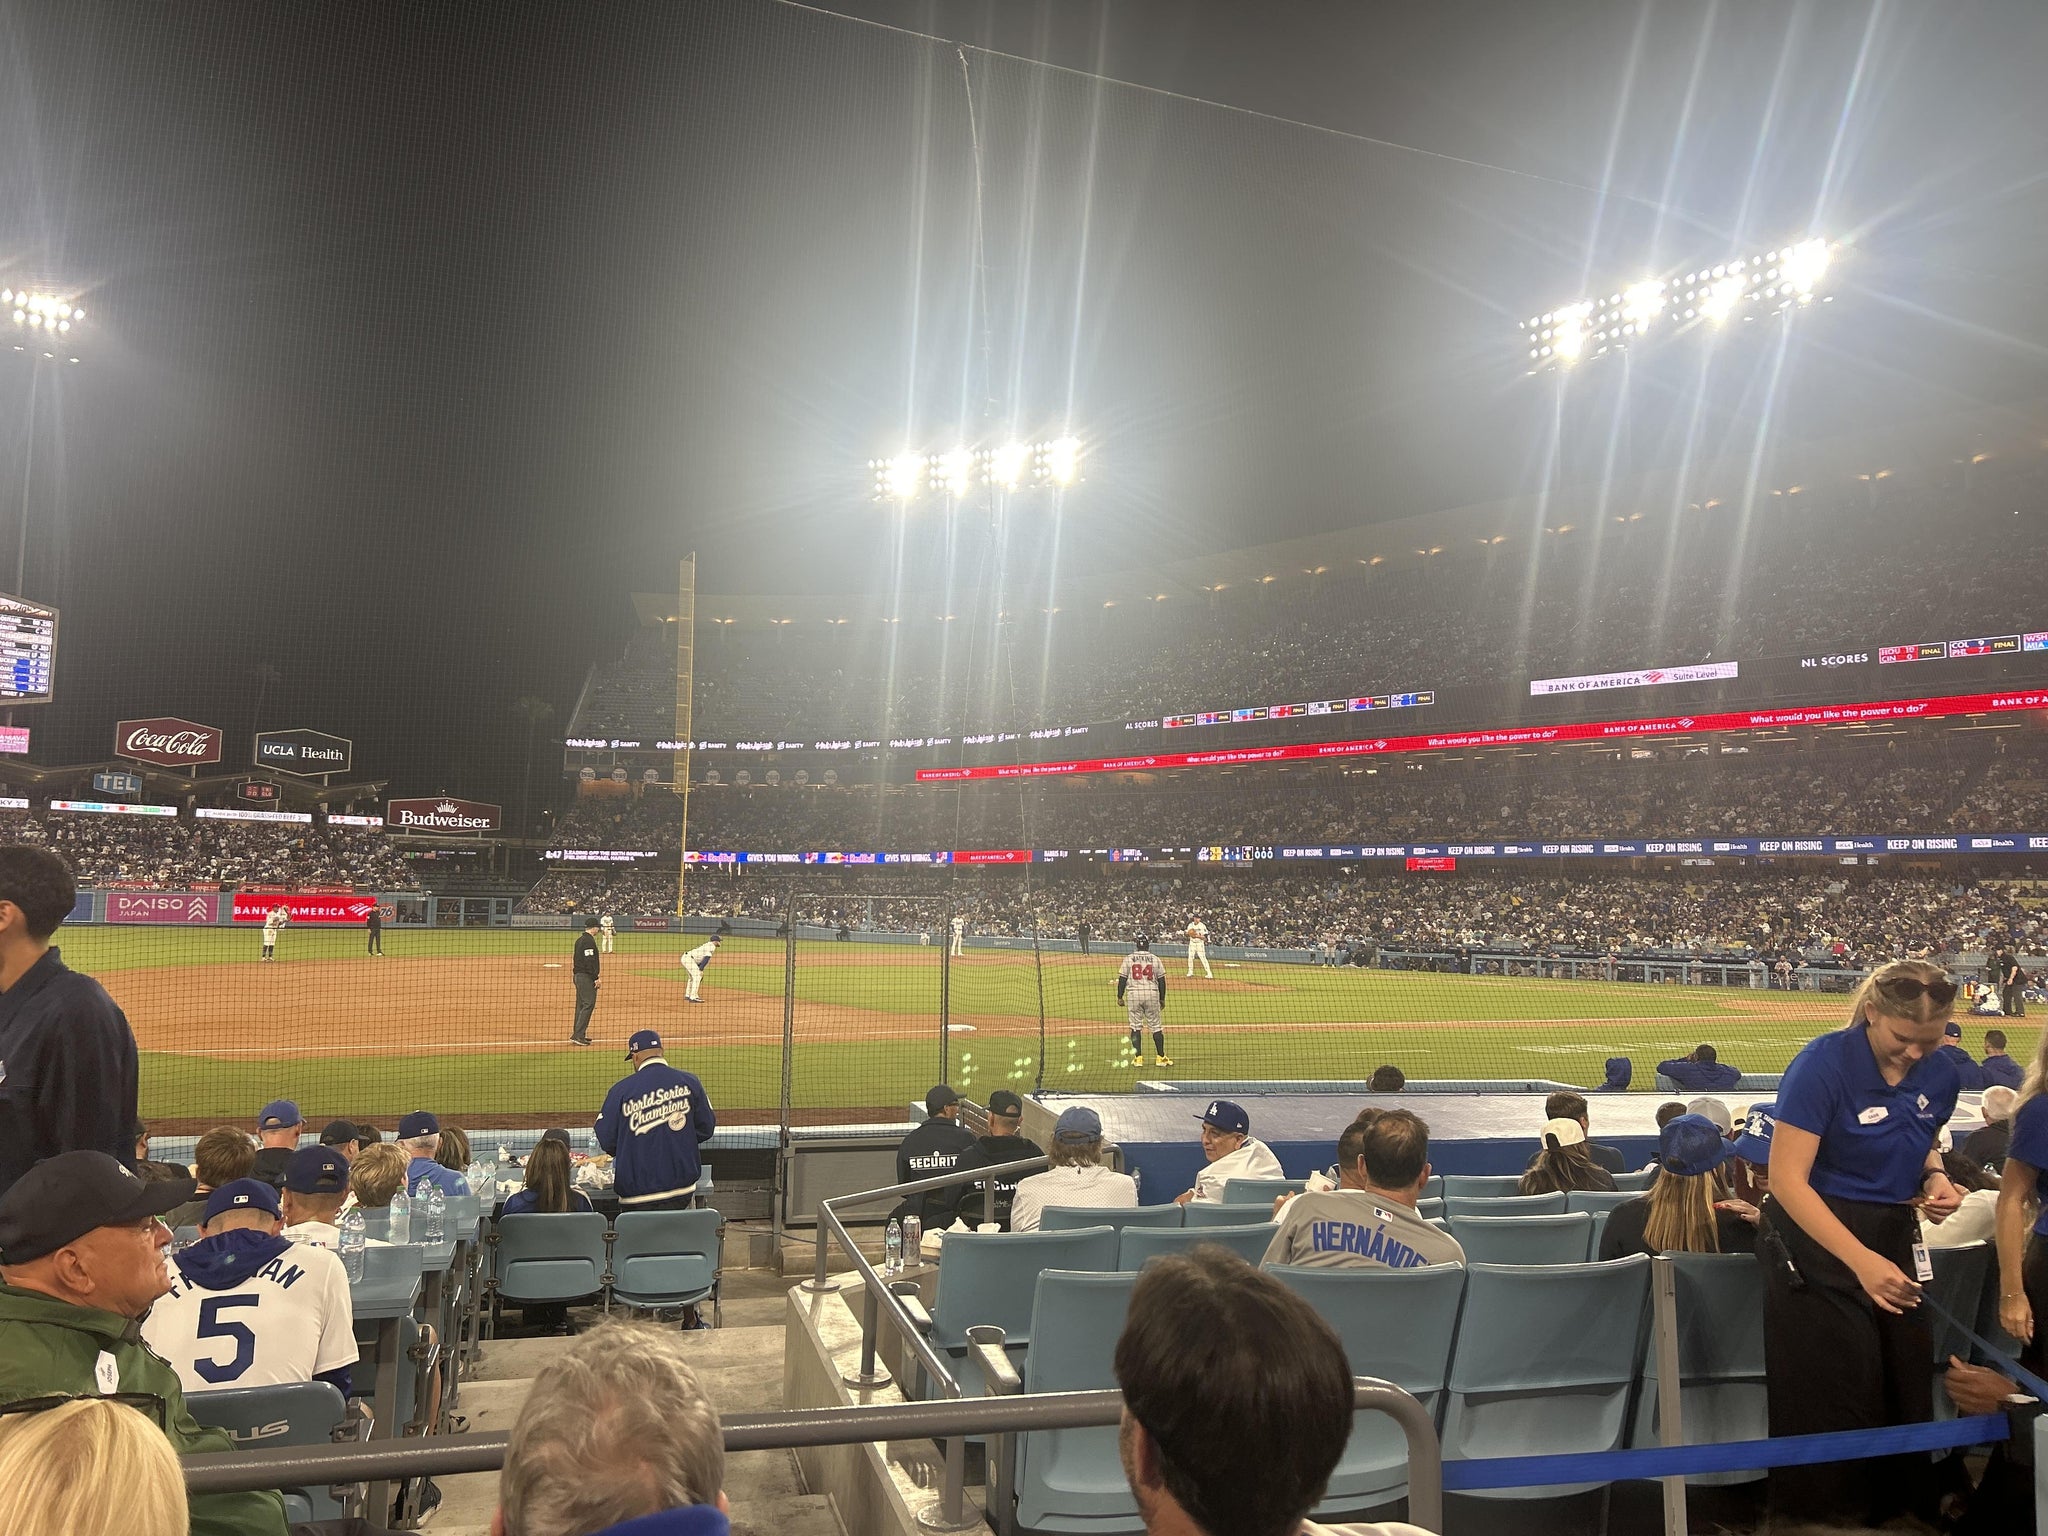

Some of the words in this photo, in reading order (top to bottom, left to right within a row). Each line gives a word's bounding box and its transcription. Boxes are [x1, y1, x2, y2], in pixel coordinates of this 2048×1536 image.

[2026, 633, 2048, 641] WSH
[1881, 648, 1900, 656] HOU
[1801, 658, 1817, 667] NL
[1821, 653, 1868, 666] SCORES
[1673, 672, 1695, 681] Suite
[1695, 669, 1718, 679] Level
[1548, 682, 1575, 692] BANK
[1578, 681, 1590, 689] OF
[1590, 676, 1640, 688] AMERICA
[1992, 697, 2023, 706] BANK
[2025, 696, 2040, 704] OF
[1750, 715, 1773, 724] What
[1775, 712, 1802, 722] would
[1804, 713, 1821, 721] you
[1823, 710, 1840, 719] like
[1842, 709, 1858, 718] the
[1860, 707, 1891, 718] power
[1893, 706, 1904, 714] to
[1134, 719, 1158, 729] SCORES
[1604, 726, 1626, 734] BANK
[1639, 723, 1676, 731] AMERICA
[126, 727, 212, 756] Coca-Cola
[1428, 738, 1445, 746] What
[1447, 736, 1467, 744] would
[1482, 734, 1494, 742] like
[1509, 733, 1531, 741] power
[263, 744, 294, 757] UCLA
[301, 747, 344, 761] Health
[1345, 744, 1373, 752] AMERICA
[100, 775, 136, 791] TEL
[1646, 844, 1664, 853] KEEP
[1665, 843, 1676, 852] ON
[1677, 843, 1702, 852] RISING
[1760, 842, 1779, 851] KEEP
[1781, 842, 1793, 851] ON
[1794, 841, 1822, 851] RISING
[1887, 840, 1909, 850] KEEP
[1912, 839, 1925, 849] ON
[1926, 839, 1957, 849] RISING
[2029, 837, 2048, 848] KEE
[1283, 849, 1296, 857] KEEP
[1305, 848, 1322, 856] RISING
[1362, 848, 1375, 856] KEEP
[1377, 848, 1385, 856] ON
[1386, 847, 1404, 855] RISING
[1448, 846, 1463, 855] KEEP
[1464, 846, 1473, 854] ON
[1474, 846, 1495, 855] RISING
[1542, 845, 1559, 854] KEEP
[1560, 845, 1569, 854] ON
[1571, 844, 1594, 853] RISING
[1254, 851, 1260, 859] 0
[1261, 851, 1267, 859] 0
[1267, 851, 1273, 859] 0
[119, 897, 183, 910] DAISO
[234, 906, 268, 915] BANK
[291, 908, 345, 916] AMERICA
[379, 906, 393, 917] 76
[1132, 963, 1153, 981] 84
[622, 1091, 655, 1118] World
[656, 1085, 691, 1104] Series
[629, 1098, 691, 1132] Champions
[909, 1156, 958, 1169] SECURIT
[1312, 1222, 1428, 1269] HERNÁNDE
[193, 1293, 260, 1384] 5
